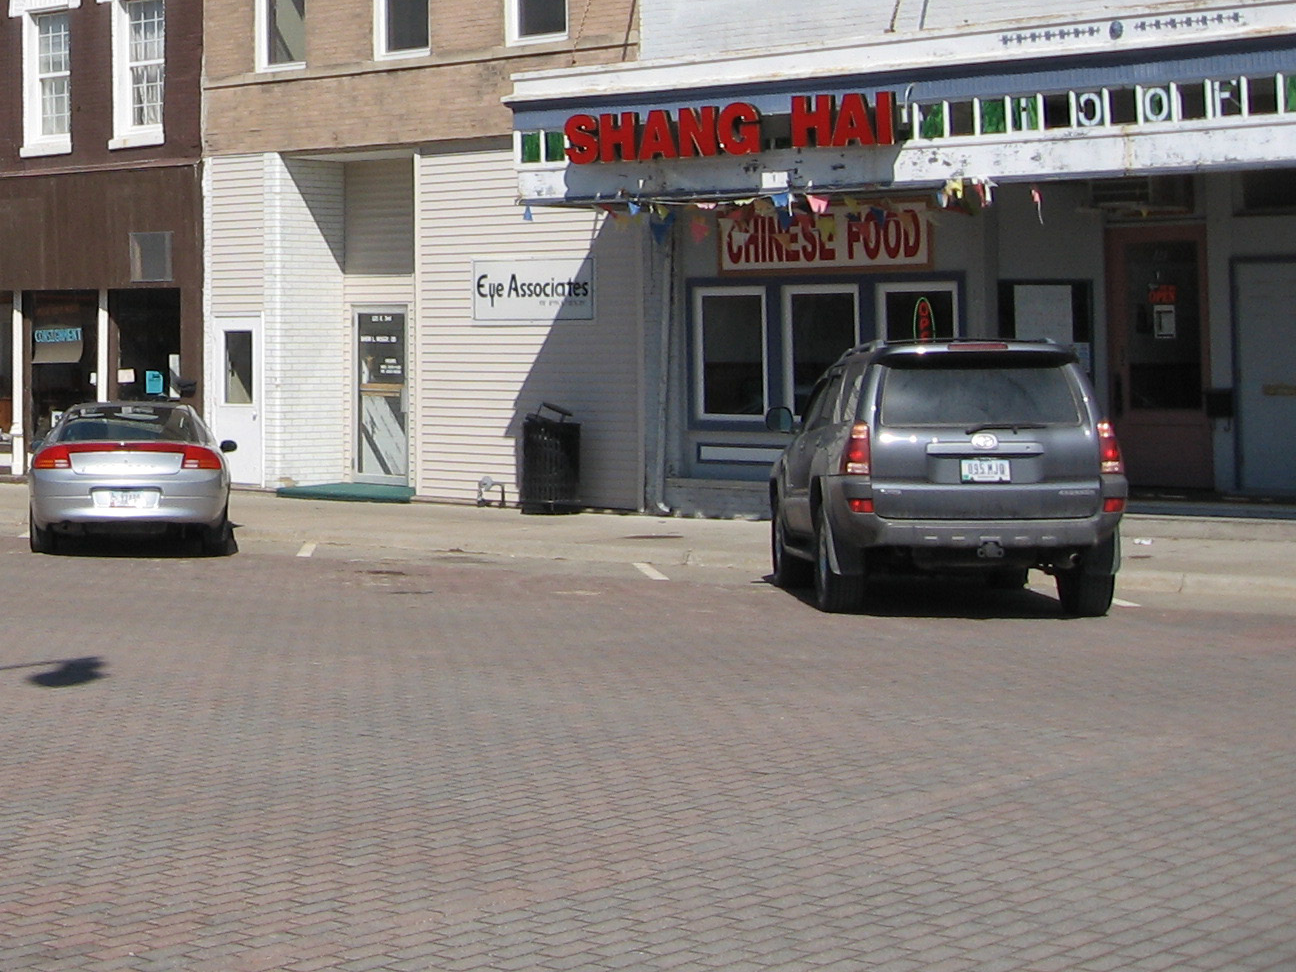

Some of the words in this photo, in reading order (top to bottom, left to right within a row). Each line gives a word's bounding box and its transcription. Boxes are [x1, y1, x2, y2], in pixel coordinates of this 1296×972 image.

[564, 102, 762, 165] SHANG
[791, 91, 896, 148] HAI
[727, 213, 836, 264] CHINESE
[847, 210, 921, 261] FOOD
[477, 274, 505, 308] Eye
[507, 273, 589, 298] Associates
[918, 301, 930, 340] OPE
